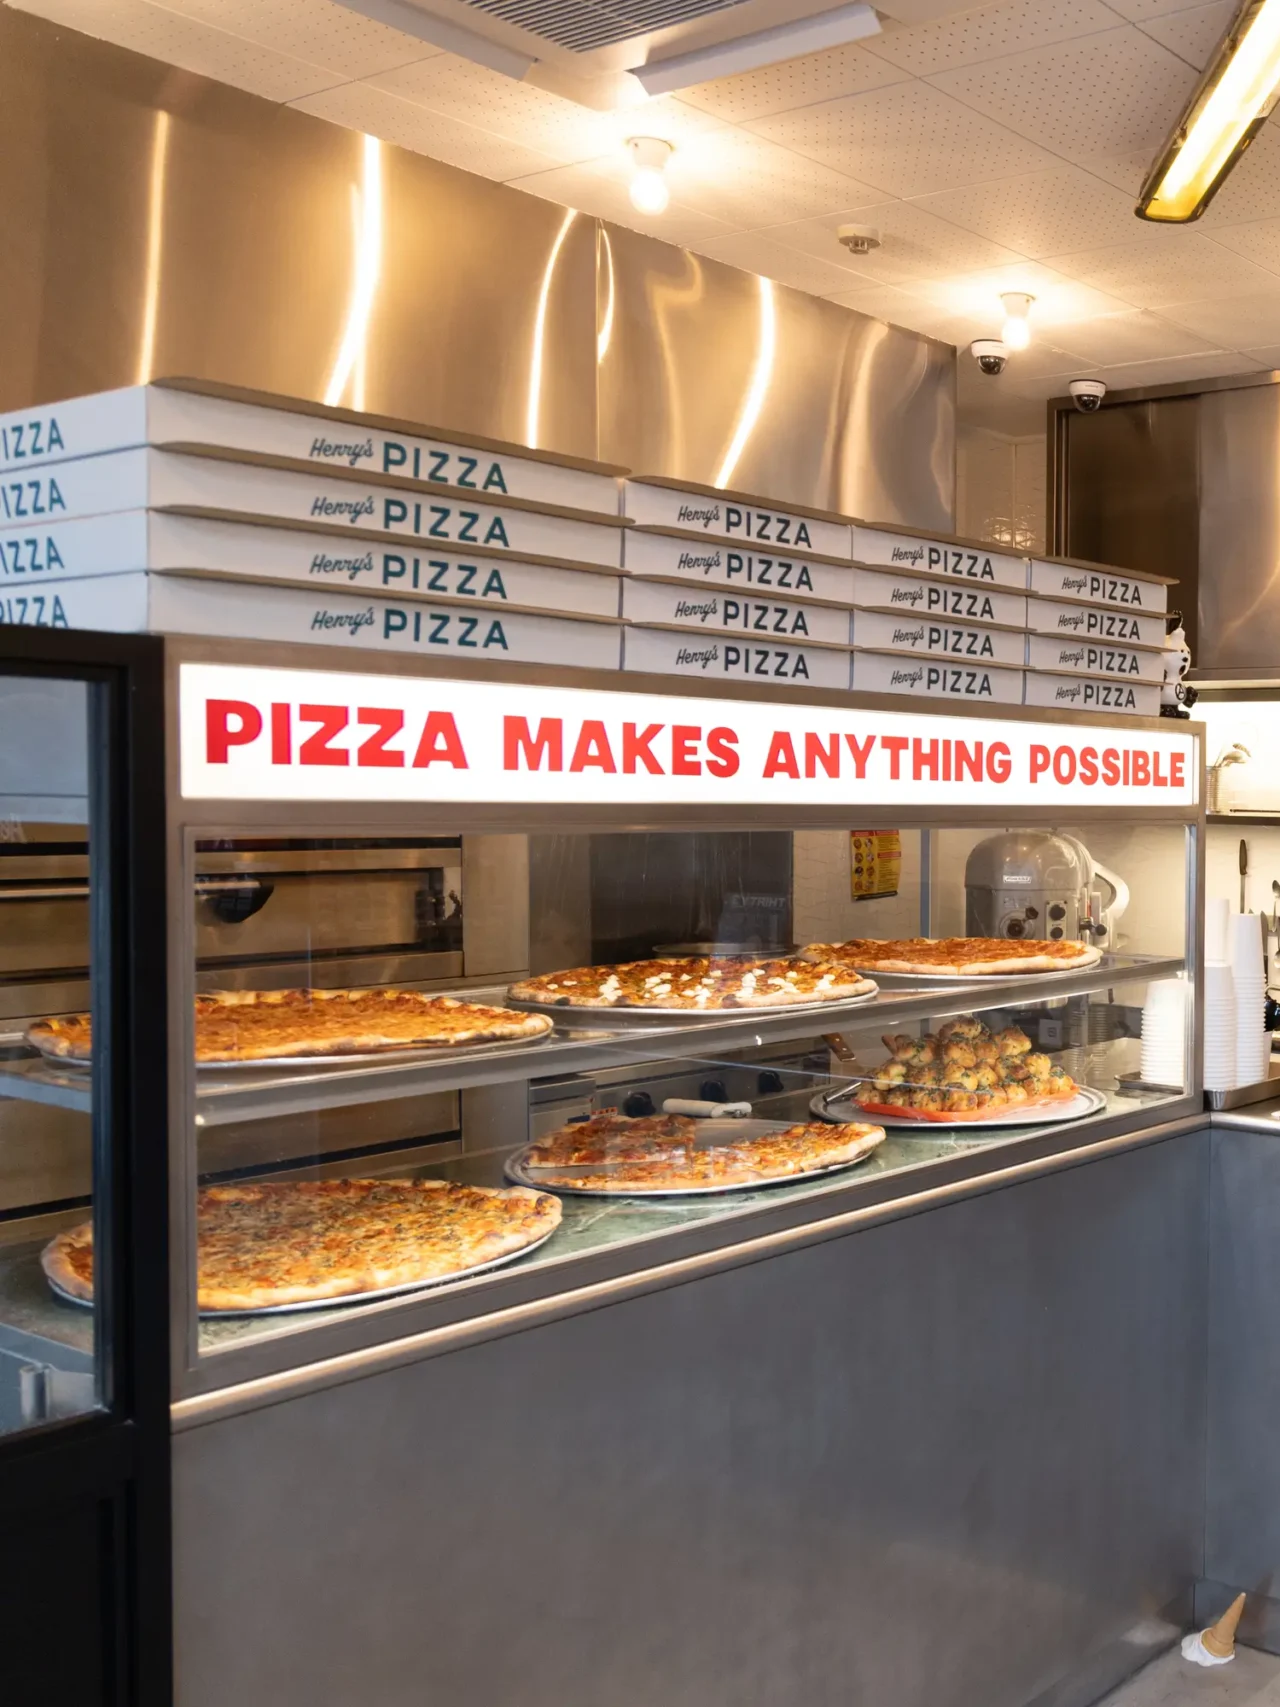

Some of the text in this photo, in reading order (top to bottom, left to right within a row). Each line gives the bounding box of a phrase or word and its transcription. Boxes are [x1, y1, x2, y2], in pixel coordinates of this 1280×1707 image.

[310, 438, 507, 494] Henry's PIZZA
[311, 496, 509, 547] Henry's PIZZA
[678, 504, 811, 548] Henry's PIZZA
[310, 552, 507, 599] Henry's PIZZA
[678, 552, 812, 590] Henry's PIZZA
[892, 546, 994, 580] Henry's PIZZA
[891, 586, 994, 620] Henry's PIZZA
[1062, 576, 1141, 605] Henry's PIZZA
[311, 608, 508, 650] Henry's PIZZA
[676, 600, 808, 634] Henry's PIZZA
[1058, 612, 1140, 640] Henry's PIZZA
[892, 626, 994, 656] Henry's PIZZA
[676, 646, 808, 678] Henry's PIZZA
[1059, 649, 1139, 674] Henry's PIZZA
[891, 667, 992, 696] Henry's PIZZA
[1056, 685, 1135, 708] Henry's PIZZA
[205, 698, 1186, 787] PIZZA MAKES ANYTHING POSSIBLE
